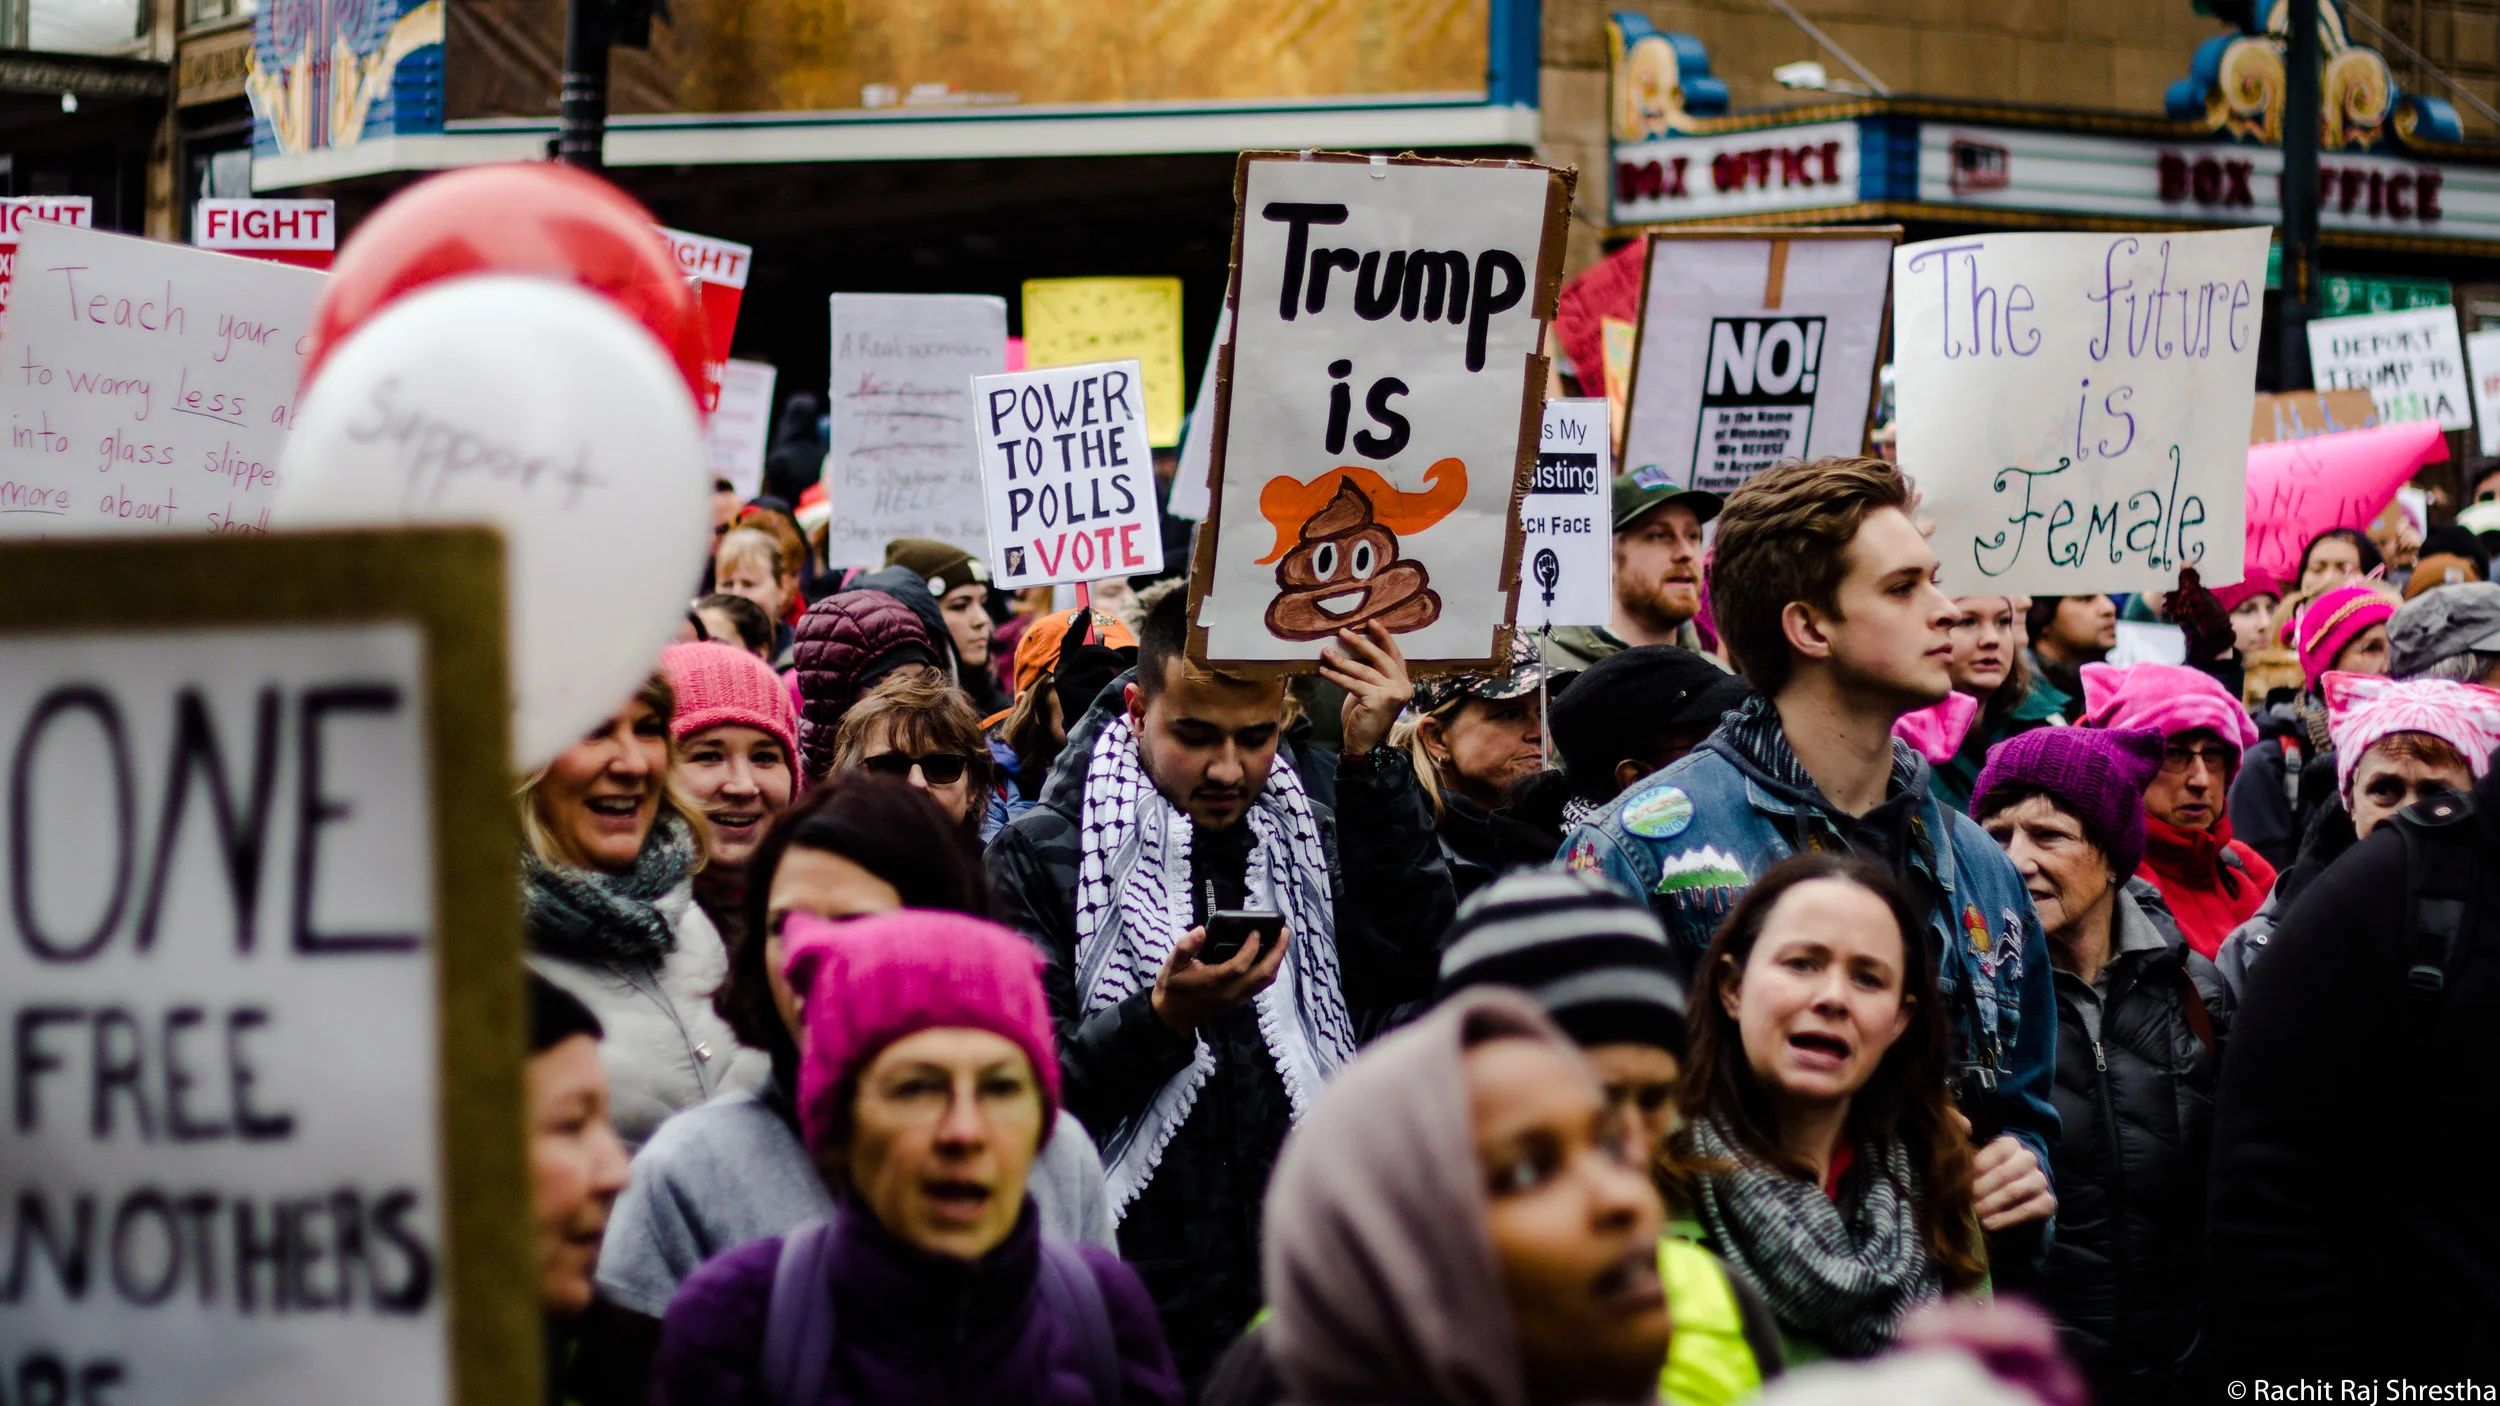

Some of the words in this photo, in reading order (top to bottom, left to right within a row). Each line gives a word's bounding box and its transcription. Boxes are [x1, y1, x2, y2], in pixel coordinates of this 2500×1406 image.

[1617, 155, 1689, 203] BOX
[1711, 140, 1843, 194] OFFICE
[2157, 149, 2254, 208] BOX
[2277, 165, 2443, 223] FFICE
[207, 209, 328, 240] FIGHT
[47, 266, 184, 336] Teach
[213, 313, 280, 363] your
[1262, 202, 1526, 372] Trump
[1908, 242, 2042, 360] The
[2087, 237, 2250, 361] future
[1706, 320, 1823, 396] NO!
[2332, 326, 2438, 357] DEPORT
[20, 345, 53, 387] to
[66, 369, 151, 422] worry
[176, 366, 247, 417] less
[988, 370, 1134, 436] POWER
[1325, 358, 1411, 460] is
[12, 410, 70, 453] into
[99, 428, 175, 473] glass
[345, 372, 610, 512] Support
[997, 437, 1043, 480] TO
[1052, 426, 1129, 472] THE
[1560, 418, 1587, 446] My
[2076, 378, 2135, 462] is
[0, 480, 71, 510] more
[99, 484, 179, 527] about
[1008, 474, 1136, 532] POLLS
[1033, 523, 1145, 577] VOTE
[8, 678, 422, 966] ONE
[1629, 788, 1660, 808] LAKE
[12, 1006, 297, 1146] FREE
